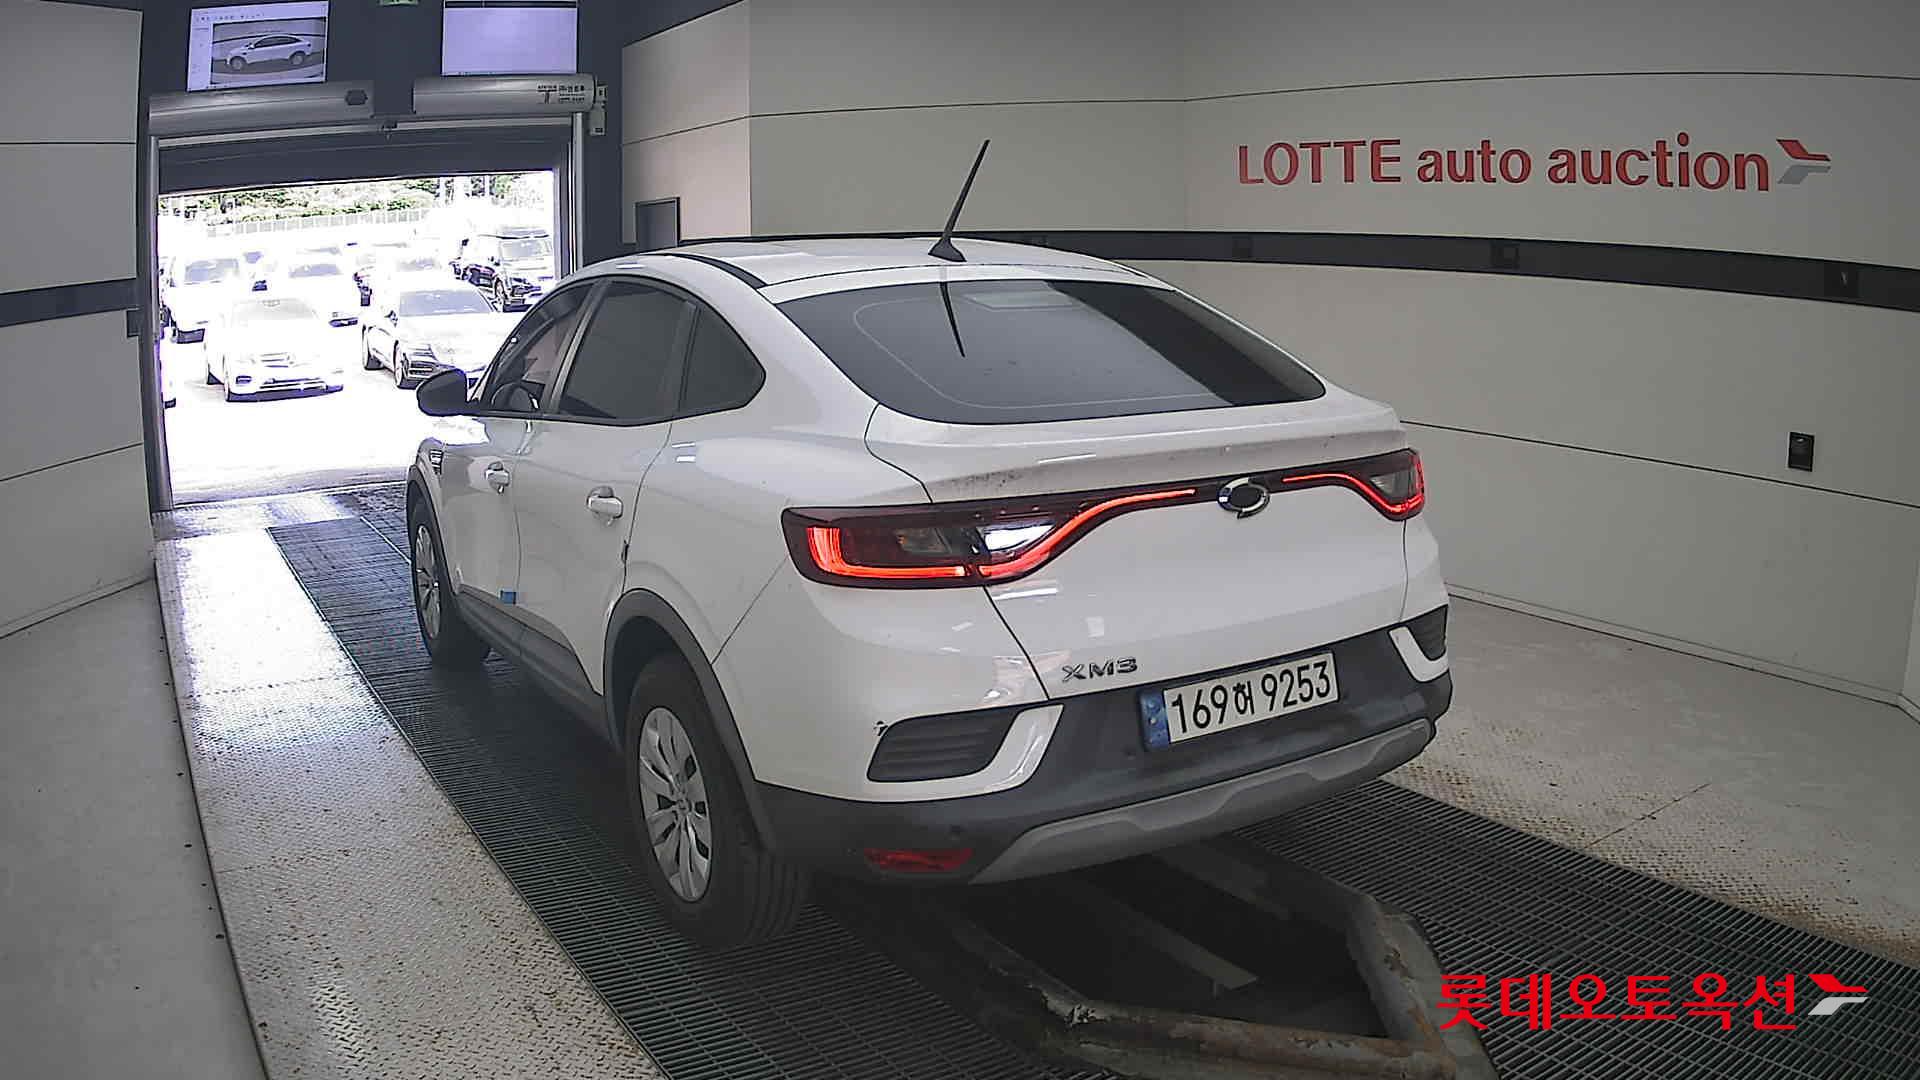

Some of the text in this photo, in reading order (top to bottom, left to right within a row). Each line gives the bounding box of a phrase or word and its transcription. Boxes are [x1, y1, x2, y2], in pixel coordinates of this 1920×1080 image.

[1238, 131, 1770, 193] LOTTE auto auction
[1061, 657, 1138, 683] XM3
[1170, 660, 1332, 735] 169허 9253
